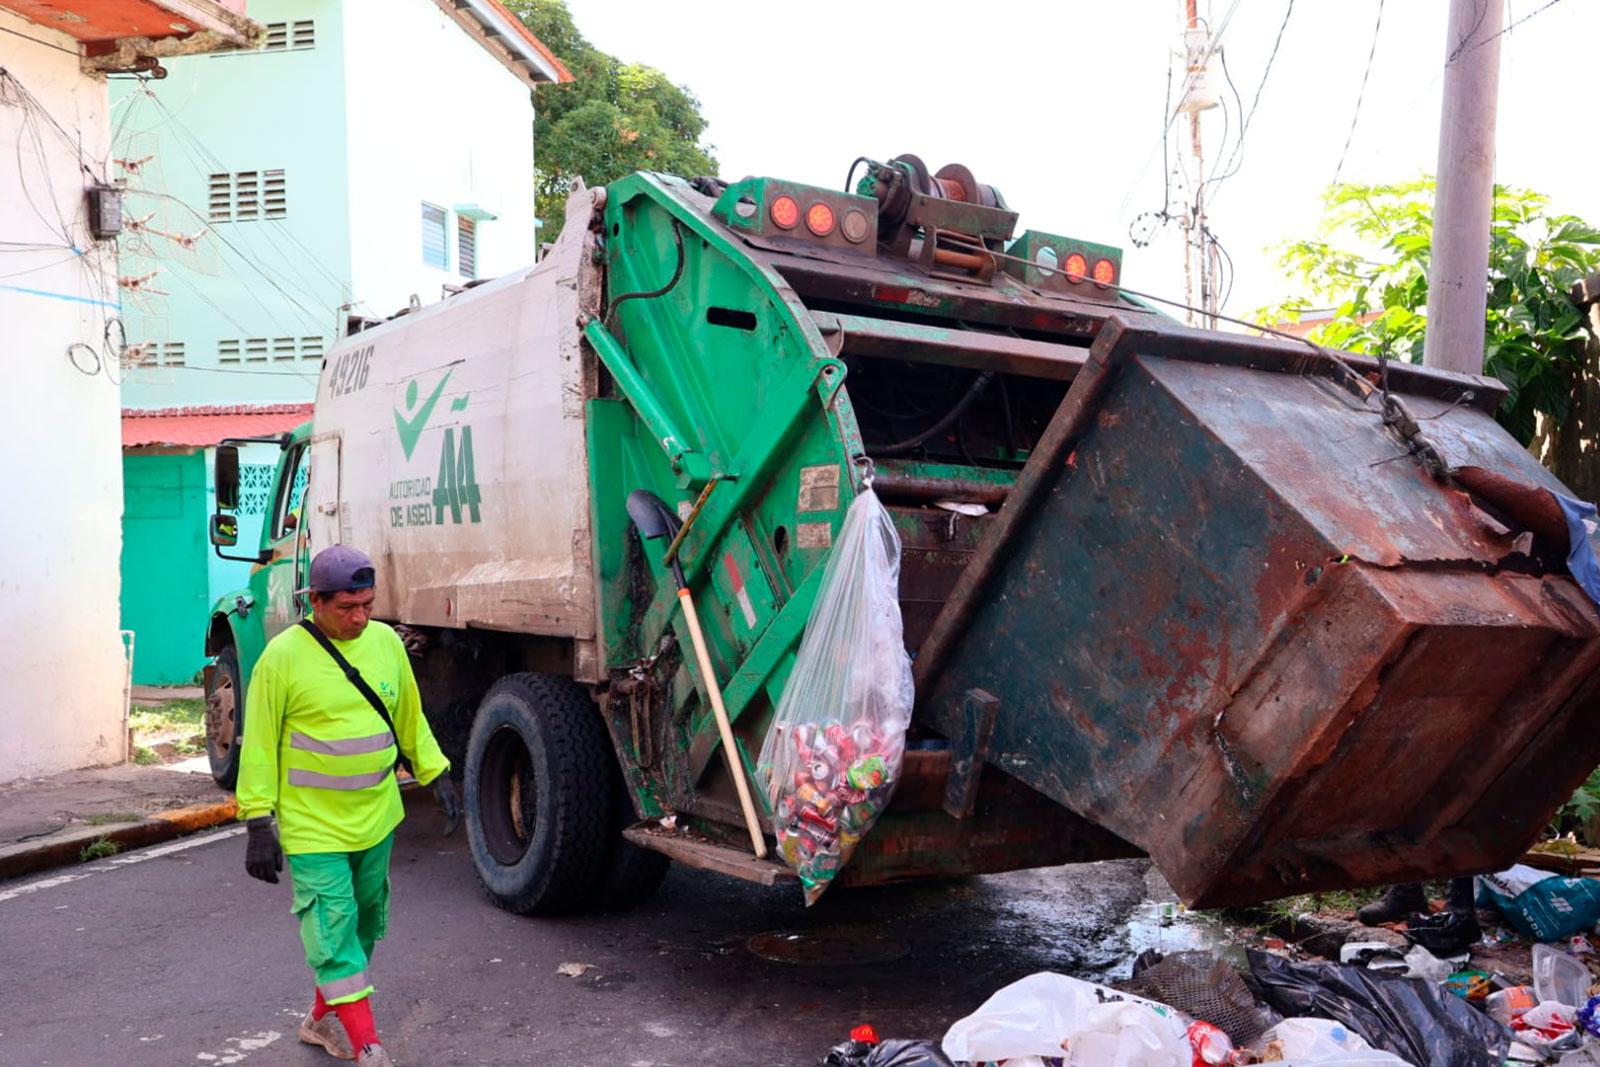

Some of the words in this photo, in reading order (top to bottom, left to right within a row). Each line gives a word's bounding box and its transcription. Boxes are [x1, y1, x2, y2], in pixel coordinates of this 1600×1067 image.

[329, 345, 374, 399] 49216
[389, 476, 431, 498] AUTORIDAD
[391, 506, 403, 527] DE
[407, 503, 432, 525] ASEO
